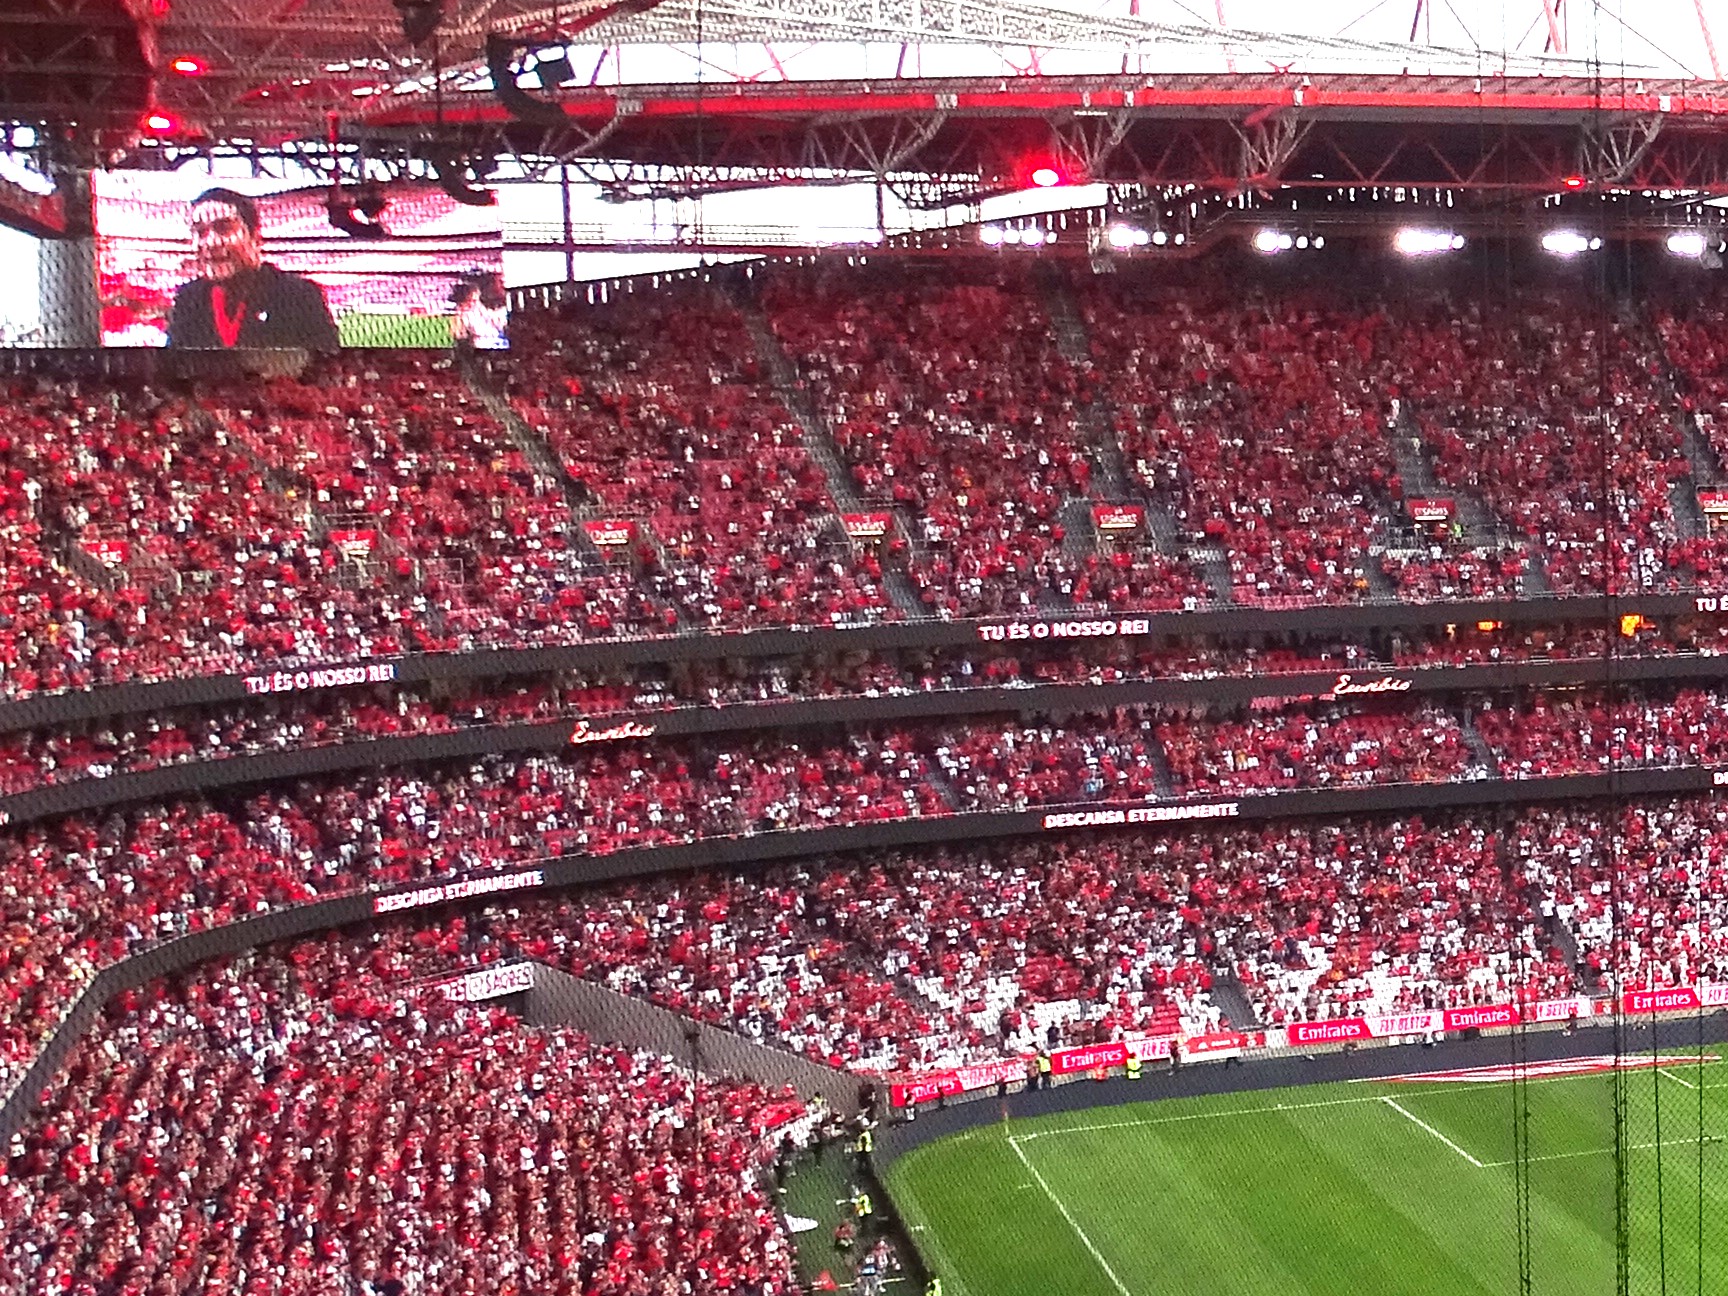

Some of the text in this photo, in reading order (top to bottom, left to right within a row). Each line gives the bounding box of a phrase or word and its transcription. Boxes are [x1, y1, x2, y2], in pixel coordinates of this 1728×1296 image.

[1696, 598, 1717, 611] TU
[979, 625, 1005, 640] TU
[1033, 623, 1049, 638] O
[1053, 621, 1116, 637] NOSSO
[1120, 620, 1149, 634] REI
[1044, 811, 1126, 829] DESCANSA
[1450, 1008, 1511, 1027] Emirates
[1298, 1023, 1361, 1042] Emirates
